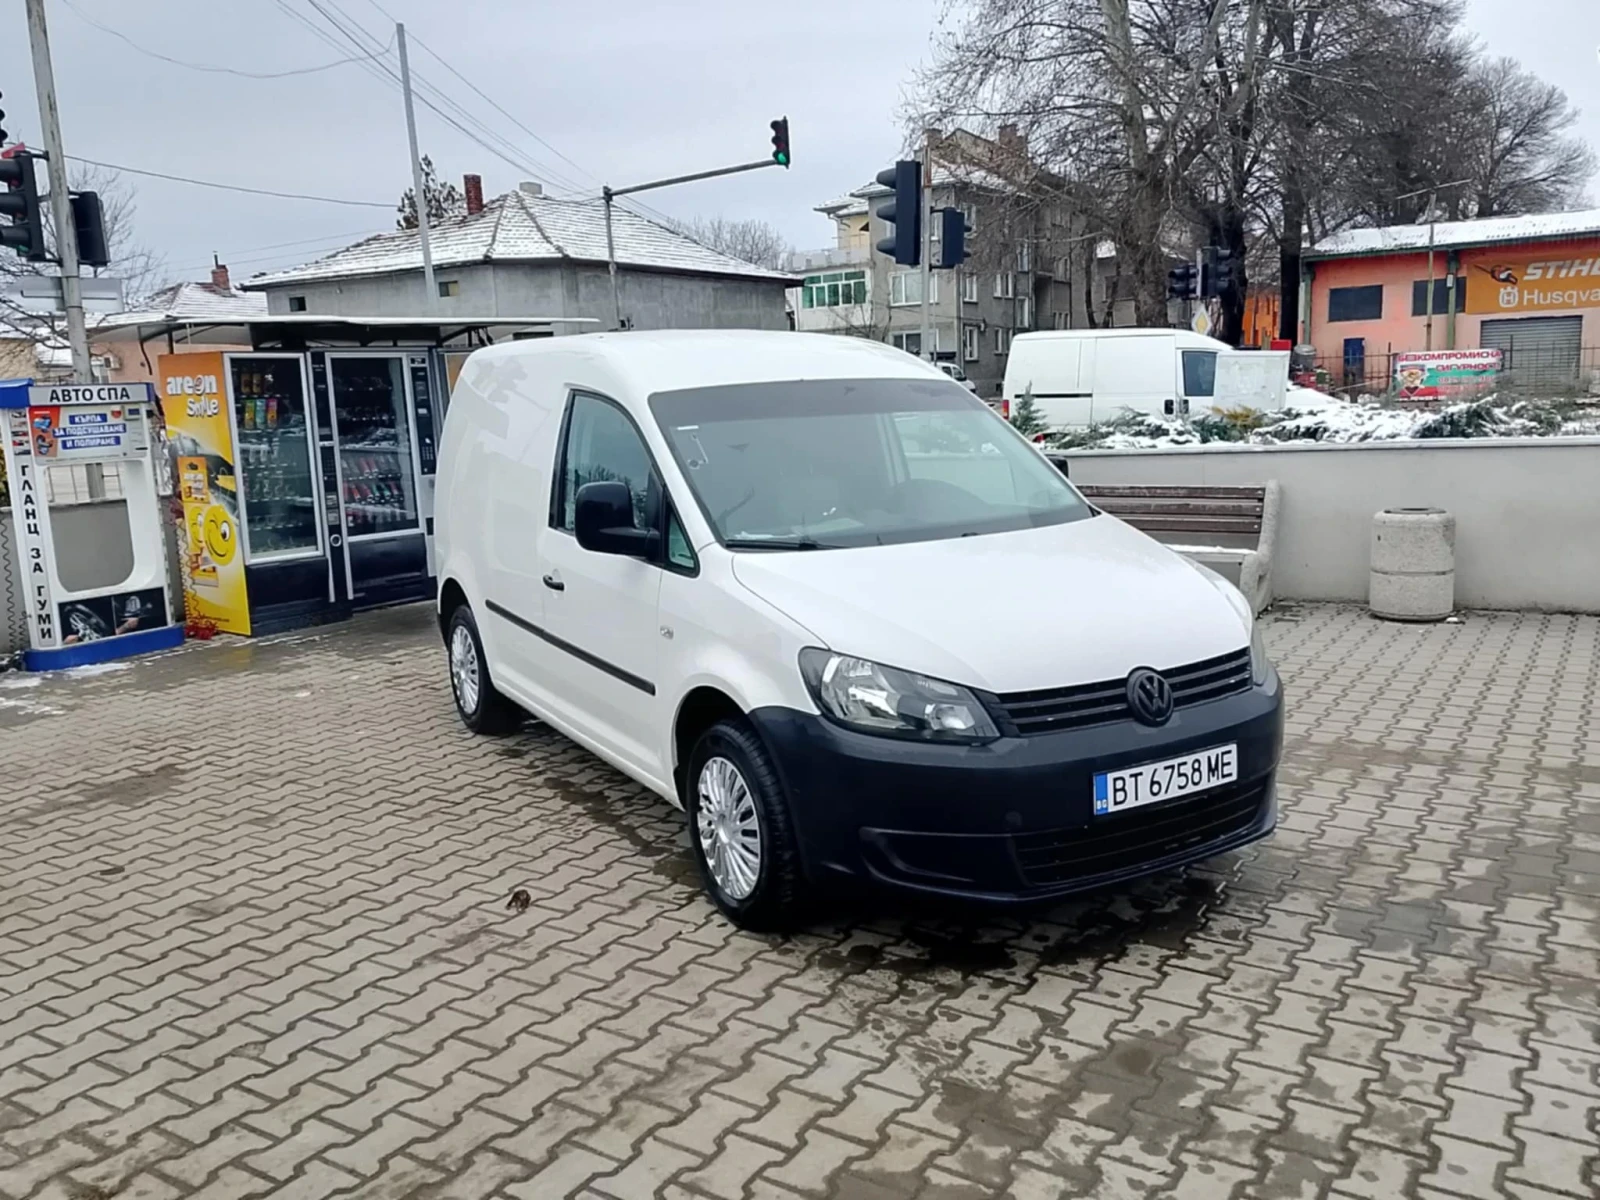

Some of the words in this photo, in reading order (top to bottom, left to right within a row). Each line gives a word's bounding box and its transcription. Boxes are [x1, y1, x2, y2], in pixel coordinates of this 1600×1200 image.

[49, 388, 94, 402] АВТО
[97, 387, 130, 401] СПА
[74, 414, 103, 422] КЪРПА
[54, 427, 66, 436] ЗА
[66, 424, 125, 435] ПОДСУШАВАНЕ
[66, 440, 73, 448] И
[74, 437, 117, 447] ПОЛИРАНЕ
[20, 465, 40, 536] ГЛАНЦ
[30, 548, 43, 574] ЗА
[36, 586, 52, 640] ГУМИ
[1112, 772, 1144, 806] BT
[1149, 759, 1201, 797] 6758
[1207, 750, 1233, 783] ME
